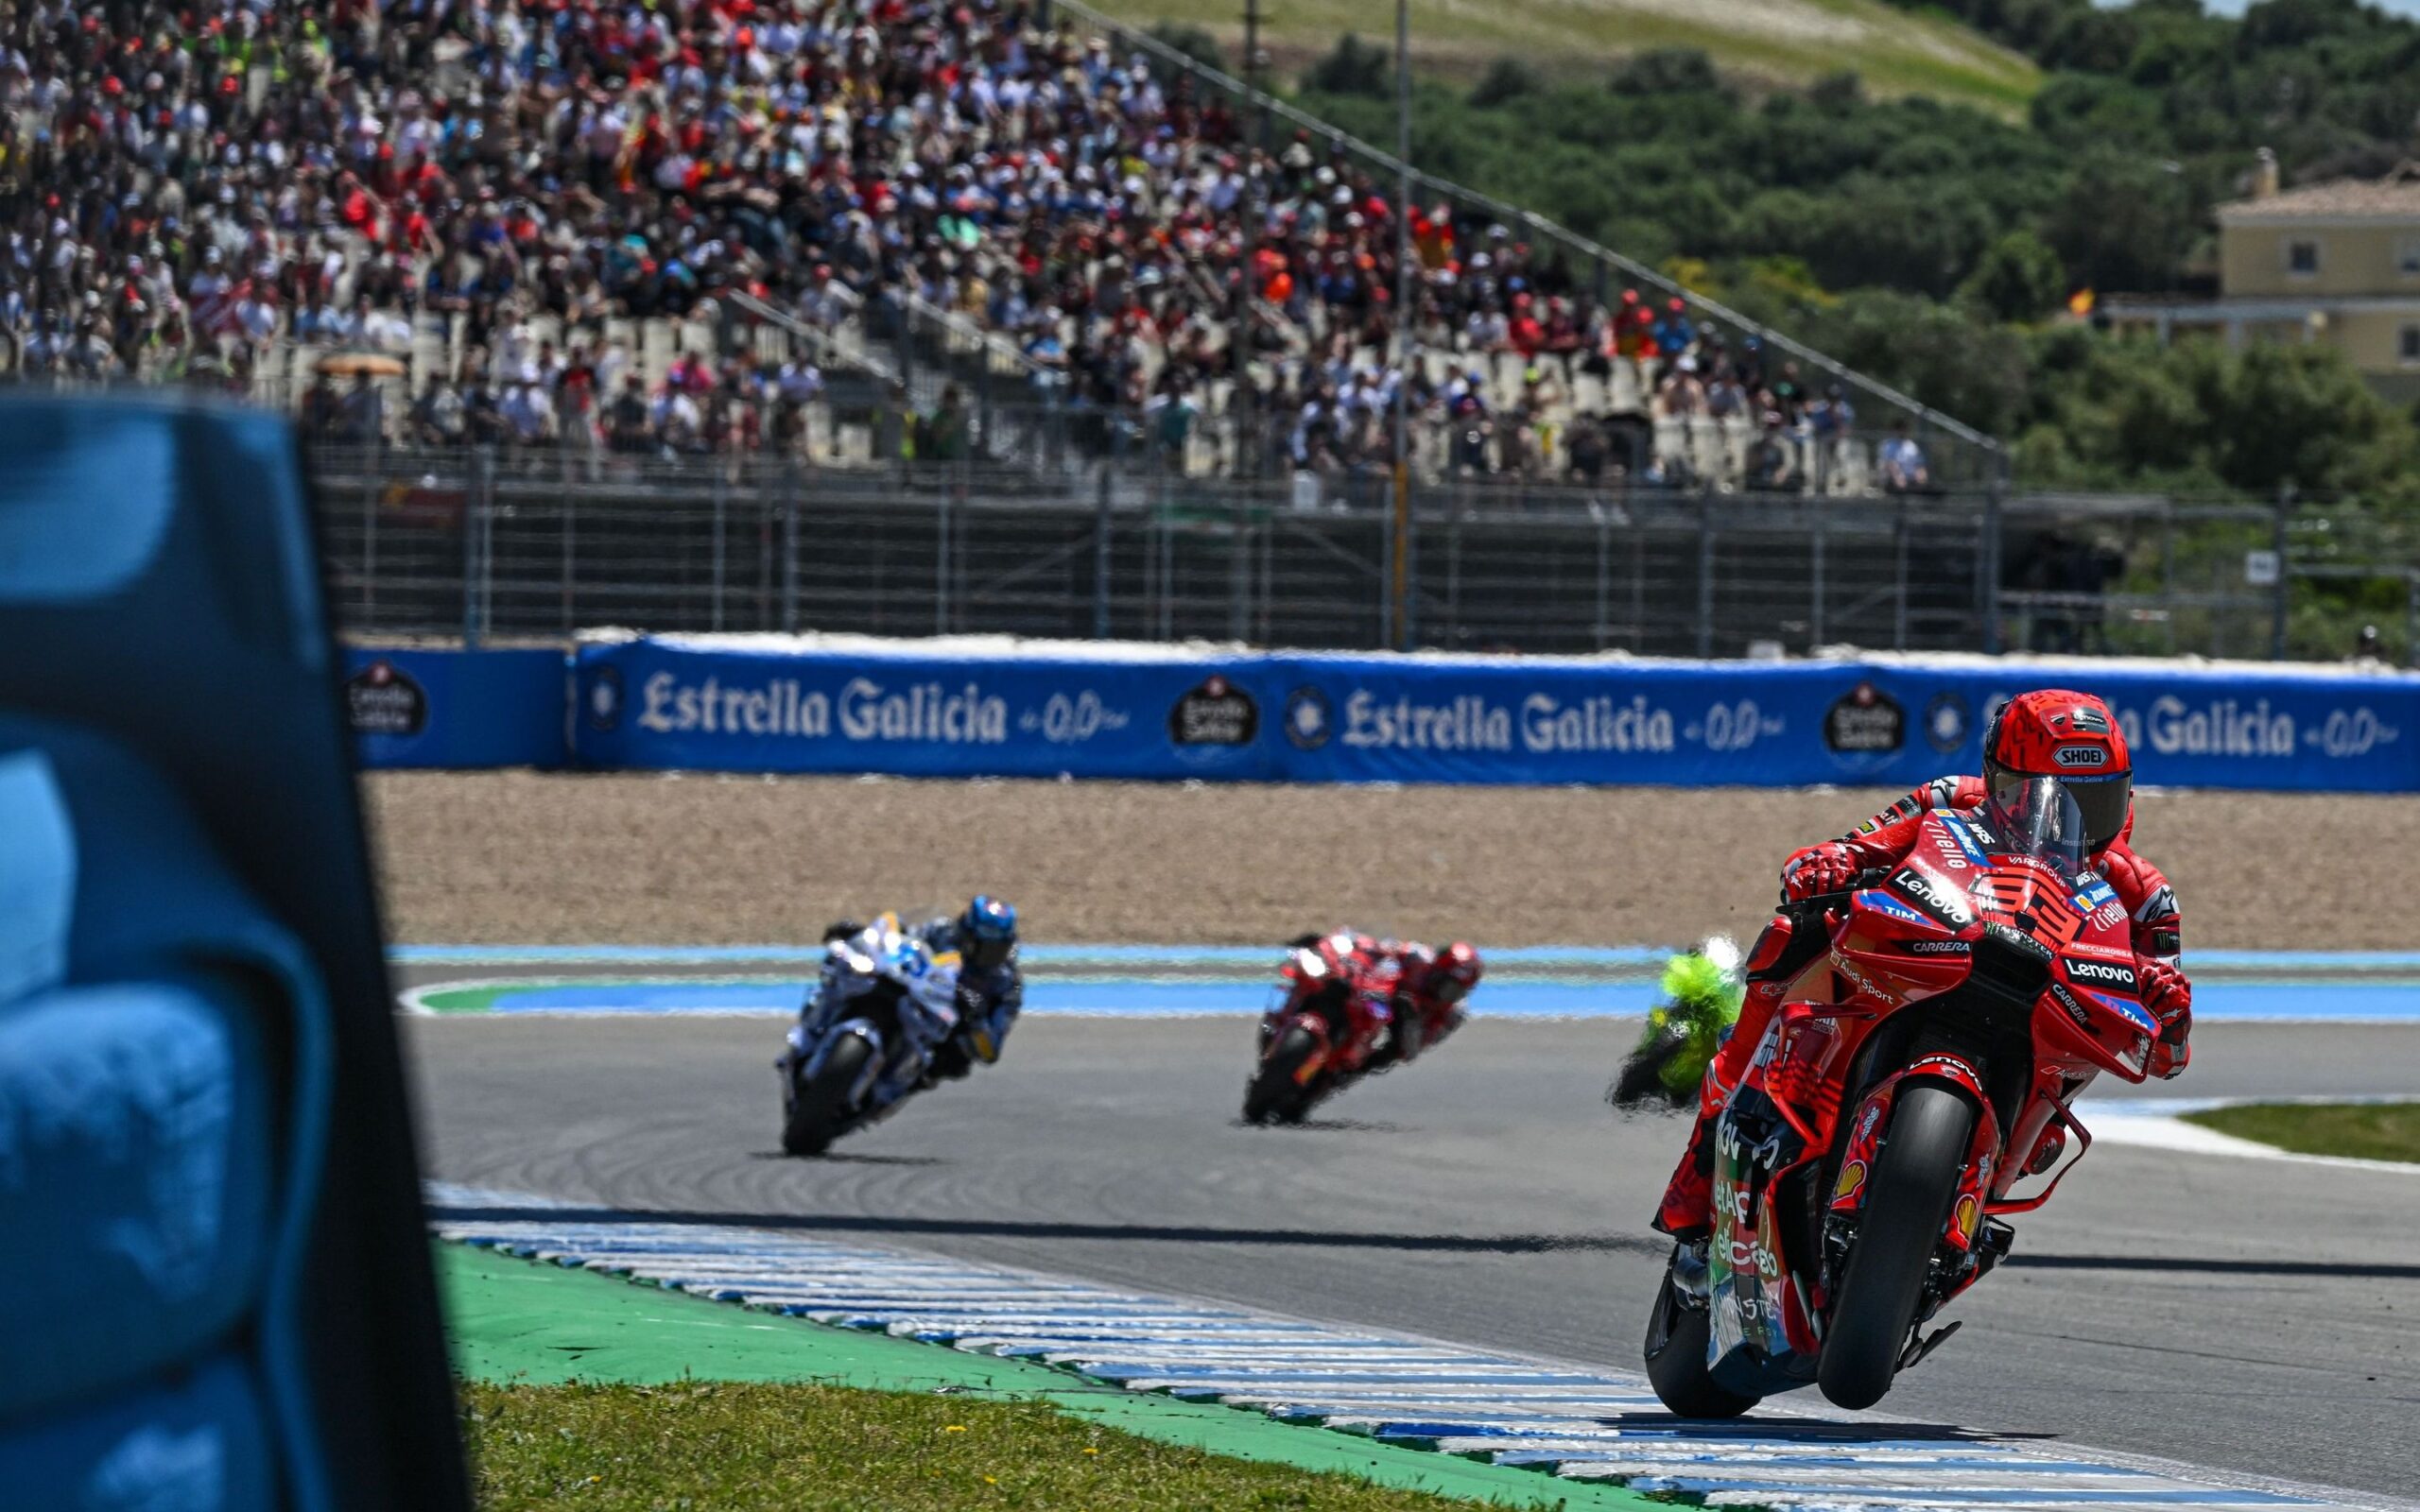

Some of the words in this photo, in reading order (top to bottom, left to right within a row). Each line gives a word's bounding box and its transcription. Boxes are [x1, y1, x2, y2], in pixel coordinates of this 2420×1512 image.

[639, 671, 832, 737] Estrella
[838, 676, 1008, 745] Galicia
[1340, 688, 1512, 752] Estrella
[1521, 693, 1675, 753] Galicia
[2148, 696, 2294, 756] Galicia
[2062, 749, 2101, 764] SHOEI
[1884, 905, 1917, 921] TIM
[1894, 869, 1968, 923] Lenovo
[1912, 942, 1971, 953] CARRERA
[1841, 958, 1861, 984] Audi
[1862, 978, 1894, 1005] Sport
[2066, 958, 2135, 984] Lenovo
[2052, 984, 2088, 1024] CARRERA
[1909, 1056, 1983, 1092] Lenovo
